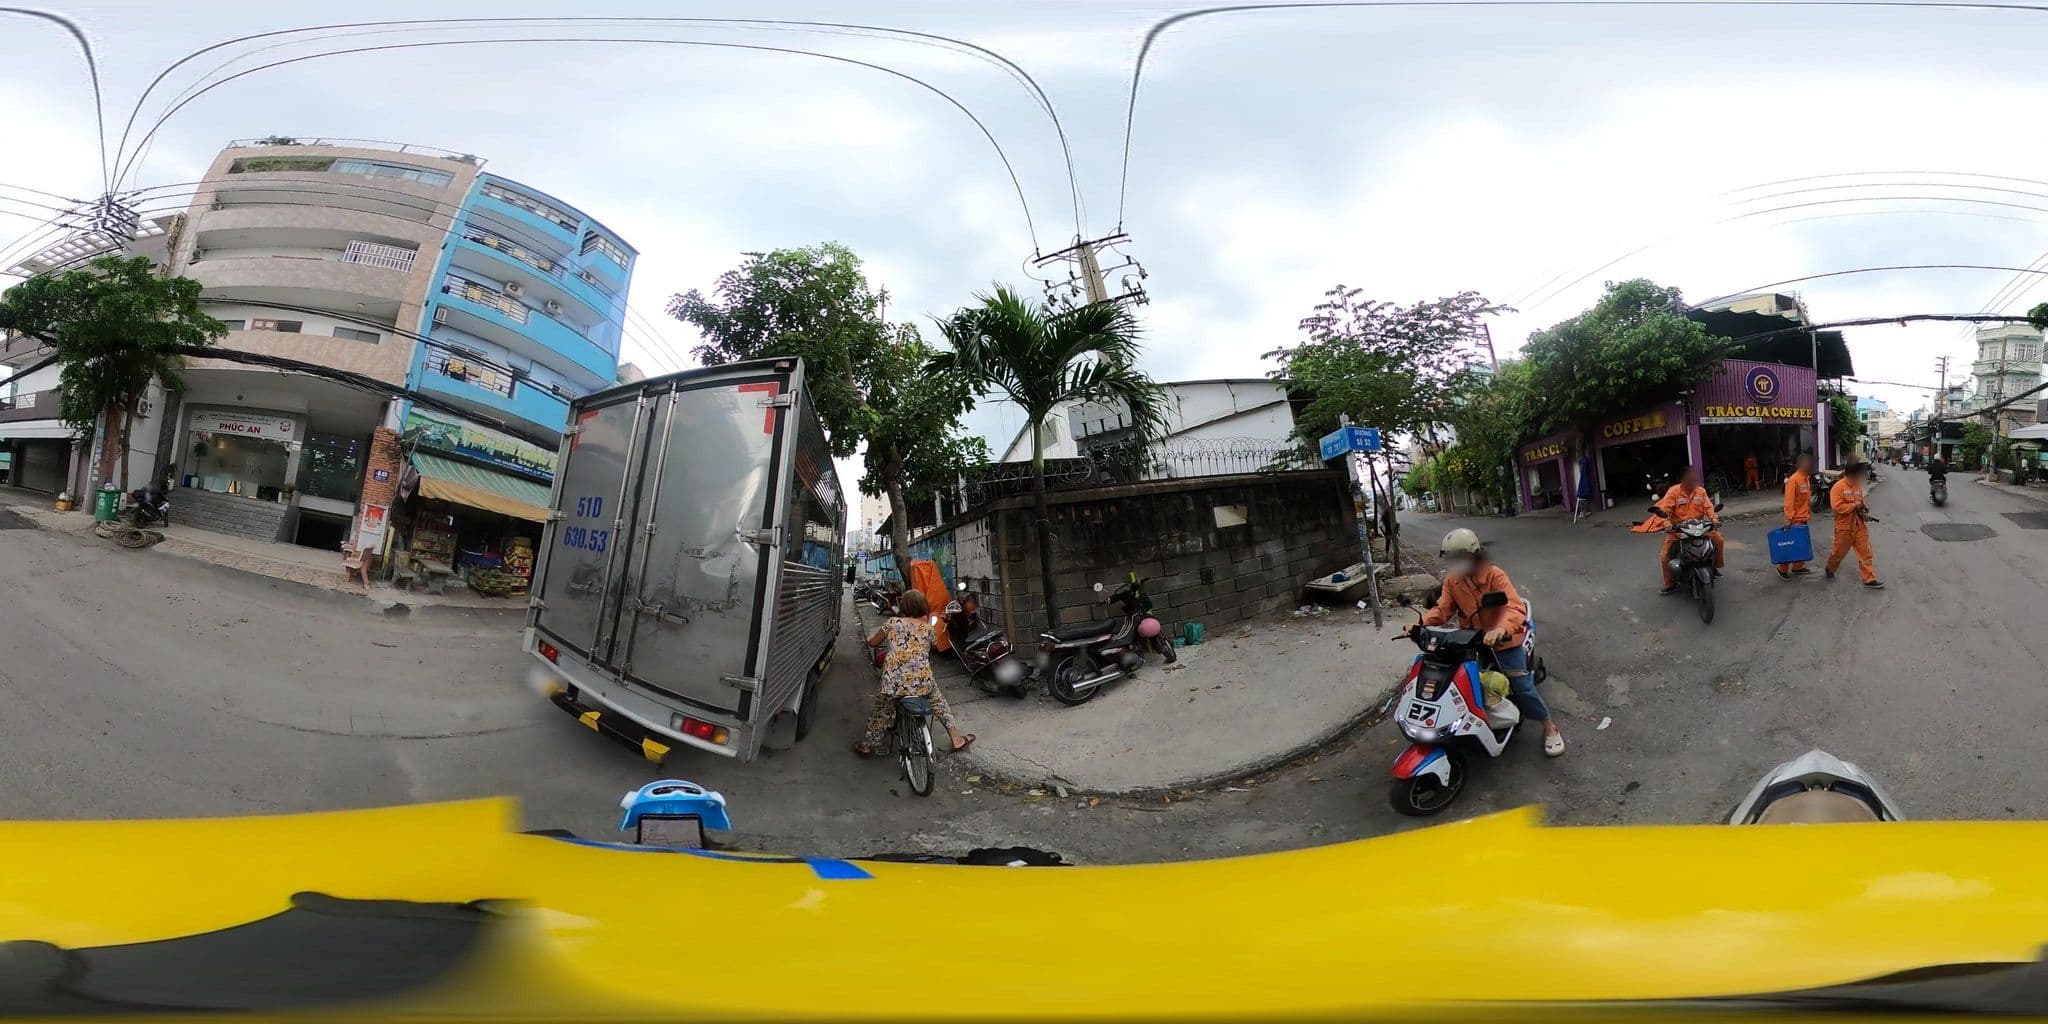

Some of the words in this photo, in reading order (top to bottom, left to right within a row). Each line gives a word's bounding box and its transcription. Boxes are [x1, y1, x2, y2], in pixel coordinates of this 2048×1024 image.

[1706, 404, 1743, 417] TRÁC
[1746, 407, 1769, 417] GIA
[1771, 407, 1813, 418] COFFEE
[219, 421, 244, 432] PHÚC
[246, 425, 261, 434] AN
[577, 496, 603, 518] 51D
[564, 526, 608, 553] 630.53
[1408, 703, 1436, 721] 27
